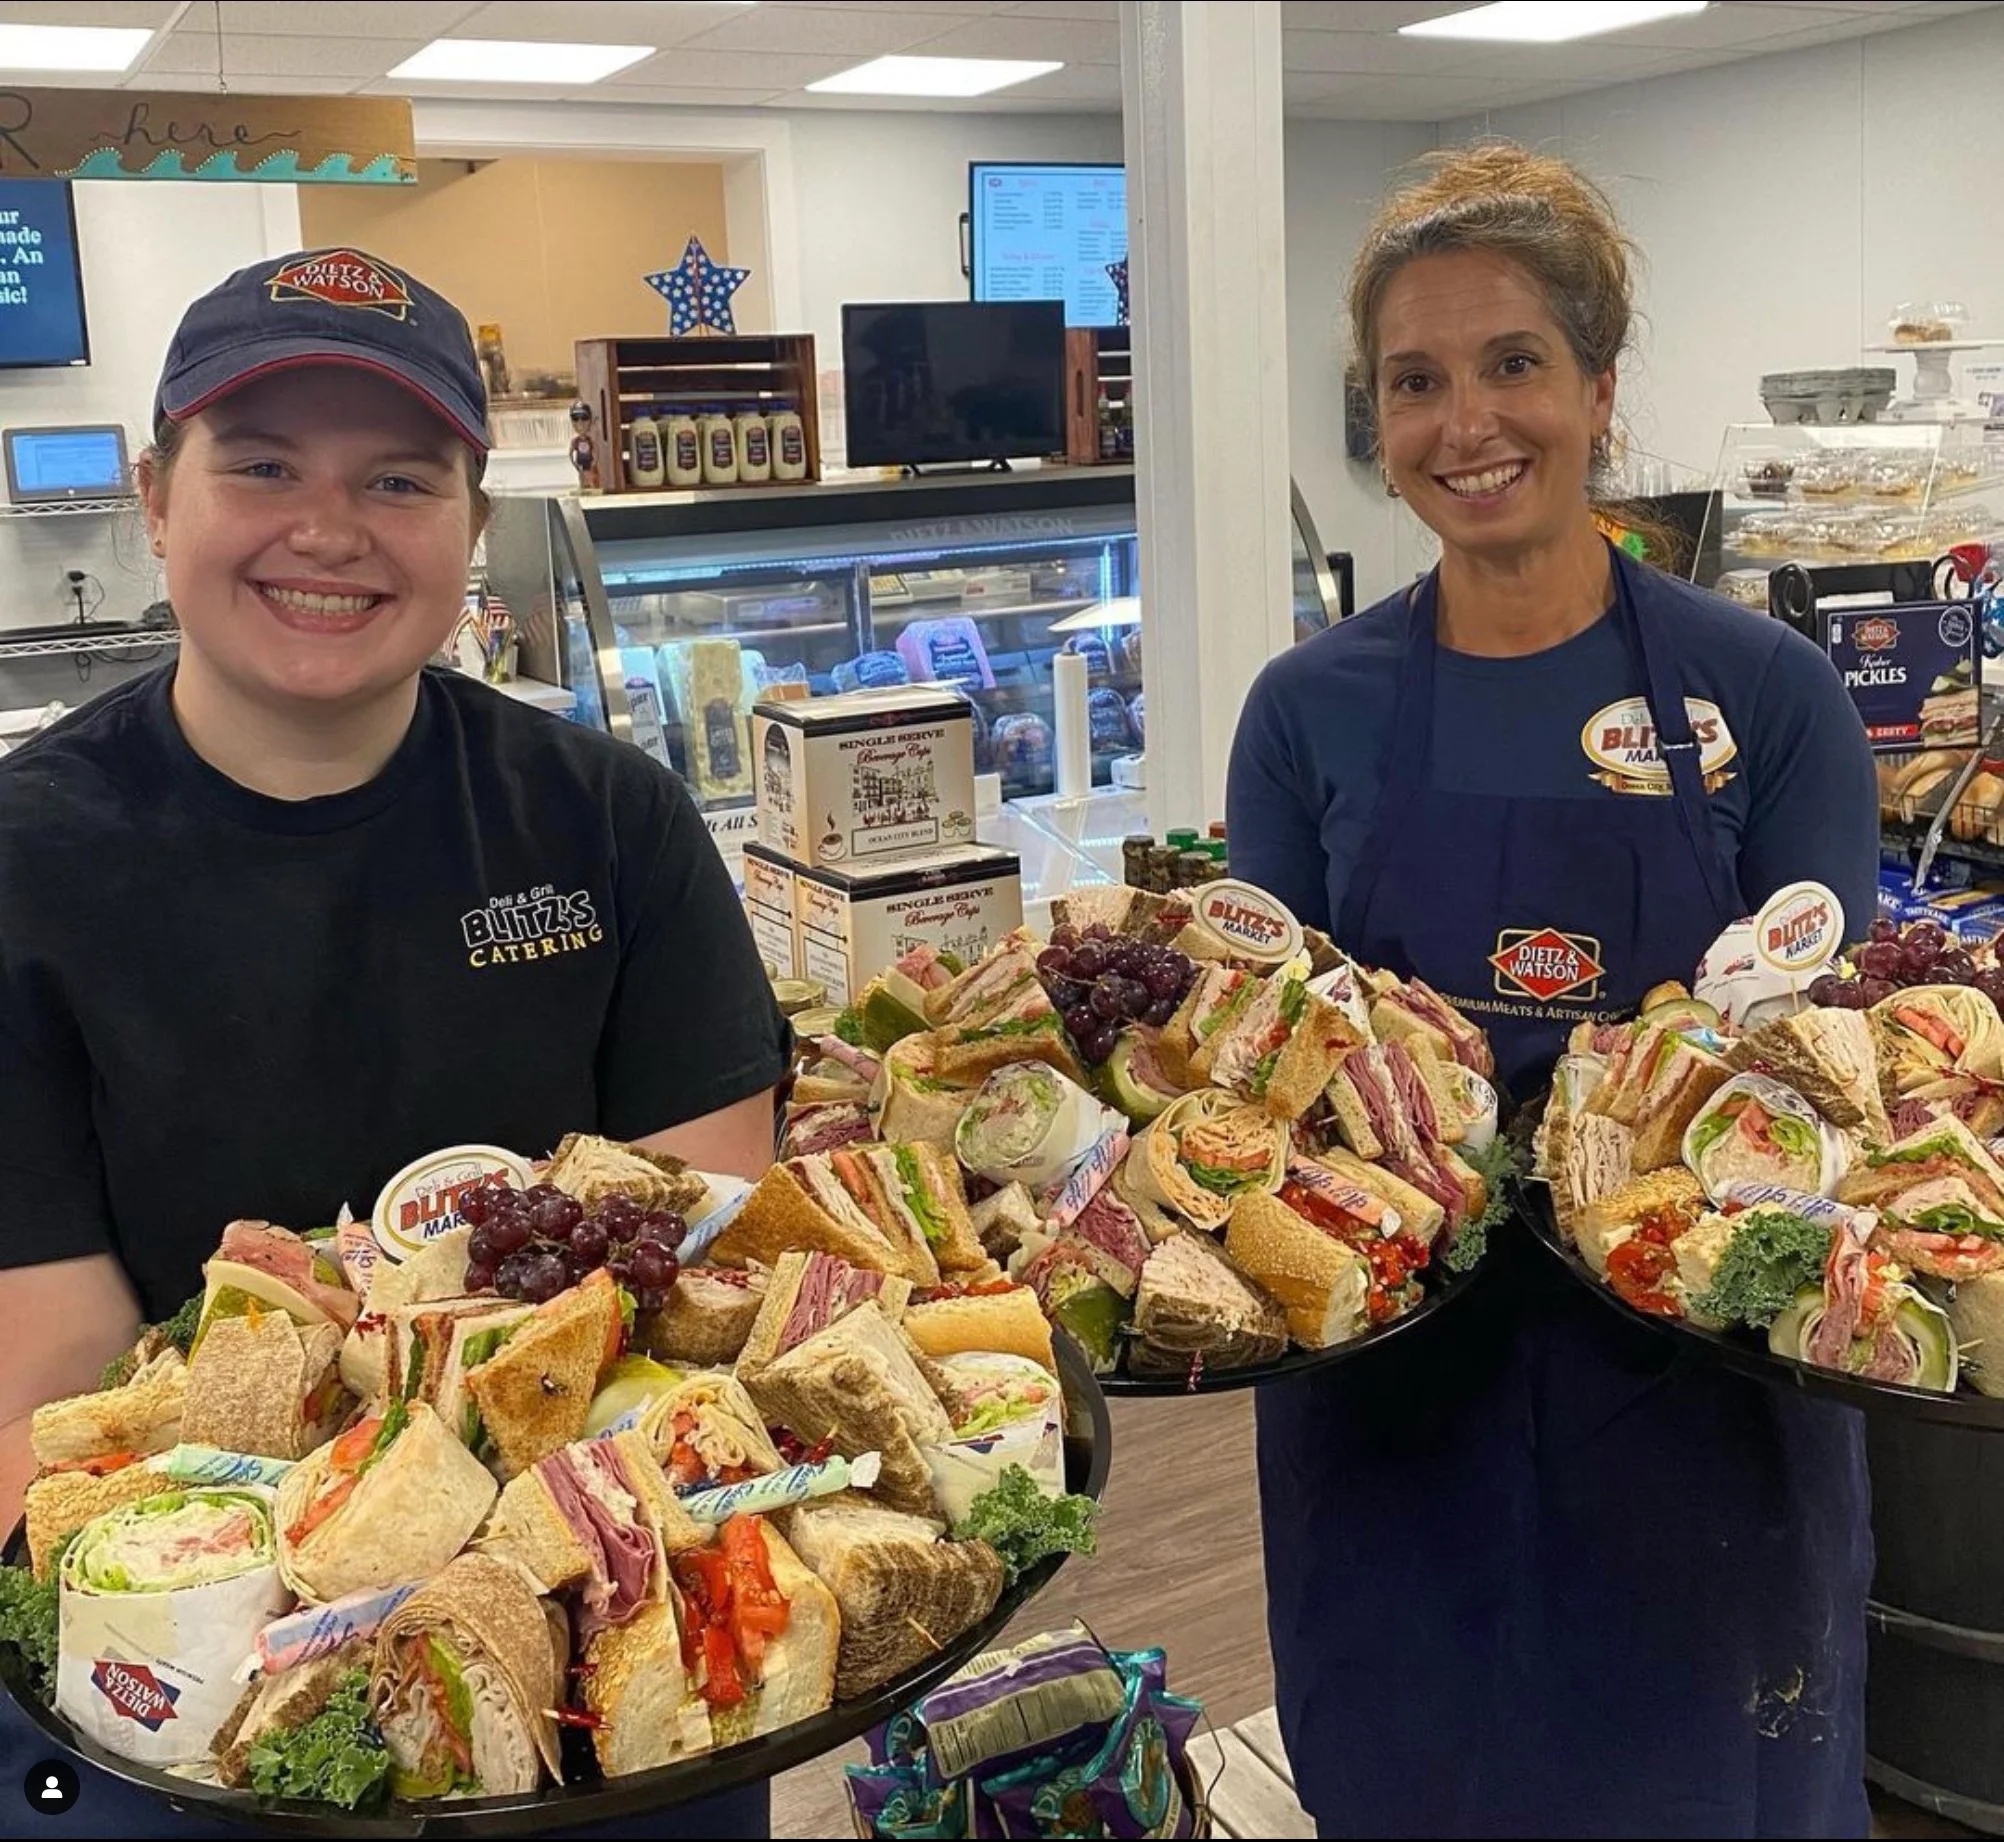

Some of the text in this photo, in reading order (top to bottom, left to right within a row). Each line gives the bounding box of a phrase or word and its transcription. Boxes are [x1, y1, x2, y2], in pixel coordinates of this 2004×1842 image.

[118, 102, 258, 147] here
[12, 247, 44, 264] An
[305, 263, 364, 280] DIETZ
[293, 275, 385, 300] WATSON
[972, 516, 1075, 537] WATSON
[1845, 667, 1908, 687] PICKLES
[839, 728, 945, 751] SINGLE SERVE
[489, 895, 514, 908] Deli
[517, 892, 527, 904] &
[886, 887, 994, 914] SINGLE SERVE
[460, 890, 597, 948] BLITZ'S
[1208, 899, 1285, 938] BLITZ'S
[1767, 902, 1828, 952] BLITZ'S
[469, 923, 603, 967] CATERING
[1222, 919, 1272, 945] MARKET
[1785, 927, 1823, 959] MARKET
[1519, 945, 1578, 966] DIETZ &
[1509, 959, 1580, 982] WATSON
[1492, 1000, 1532, 1017] MEATS
[1534, 1006, 1545, 1018] &
[1546, 1006, 1597, 1022] ARTISAN
[424, 1213, 468, 1239] MAR
[105, 1662, 165, 1711] WATSON
[114, 1683, 151, 1718] DIETZ
